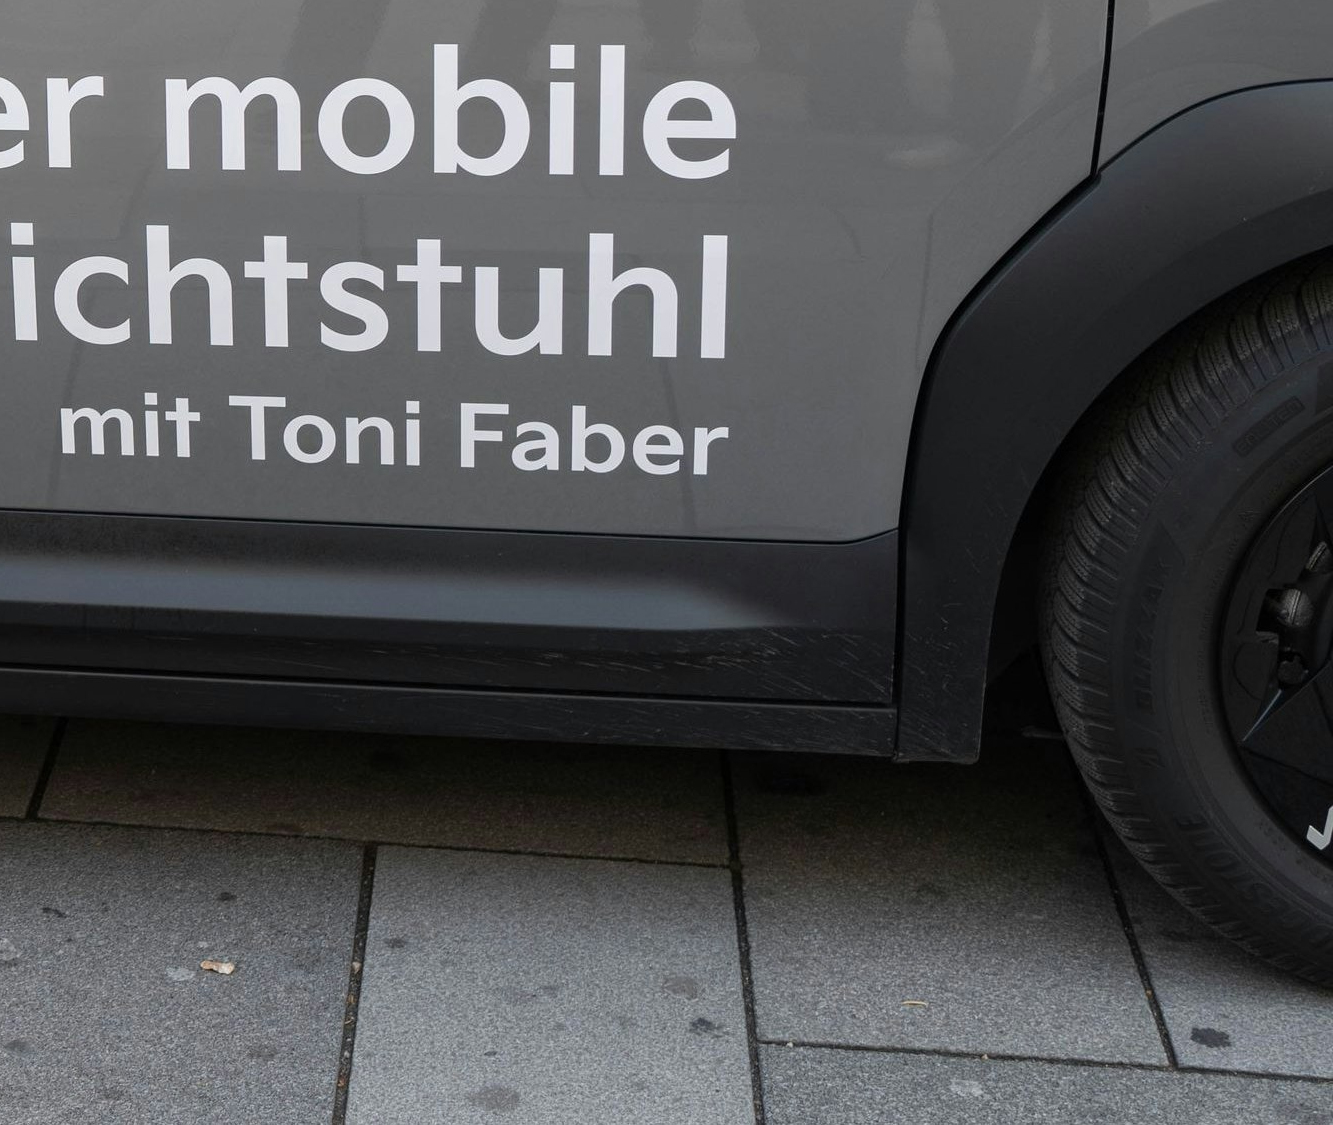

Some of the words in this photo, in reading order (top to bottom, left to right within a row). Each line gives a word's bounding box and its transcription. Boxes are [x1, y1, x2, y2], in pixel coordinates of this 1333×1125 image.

[165, 43, 737, 180] mobile
[60, 392, 201, 458] mit
[228, 395, 420, 466] Toni
[460, 402, 729, 475] Faber
